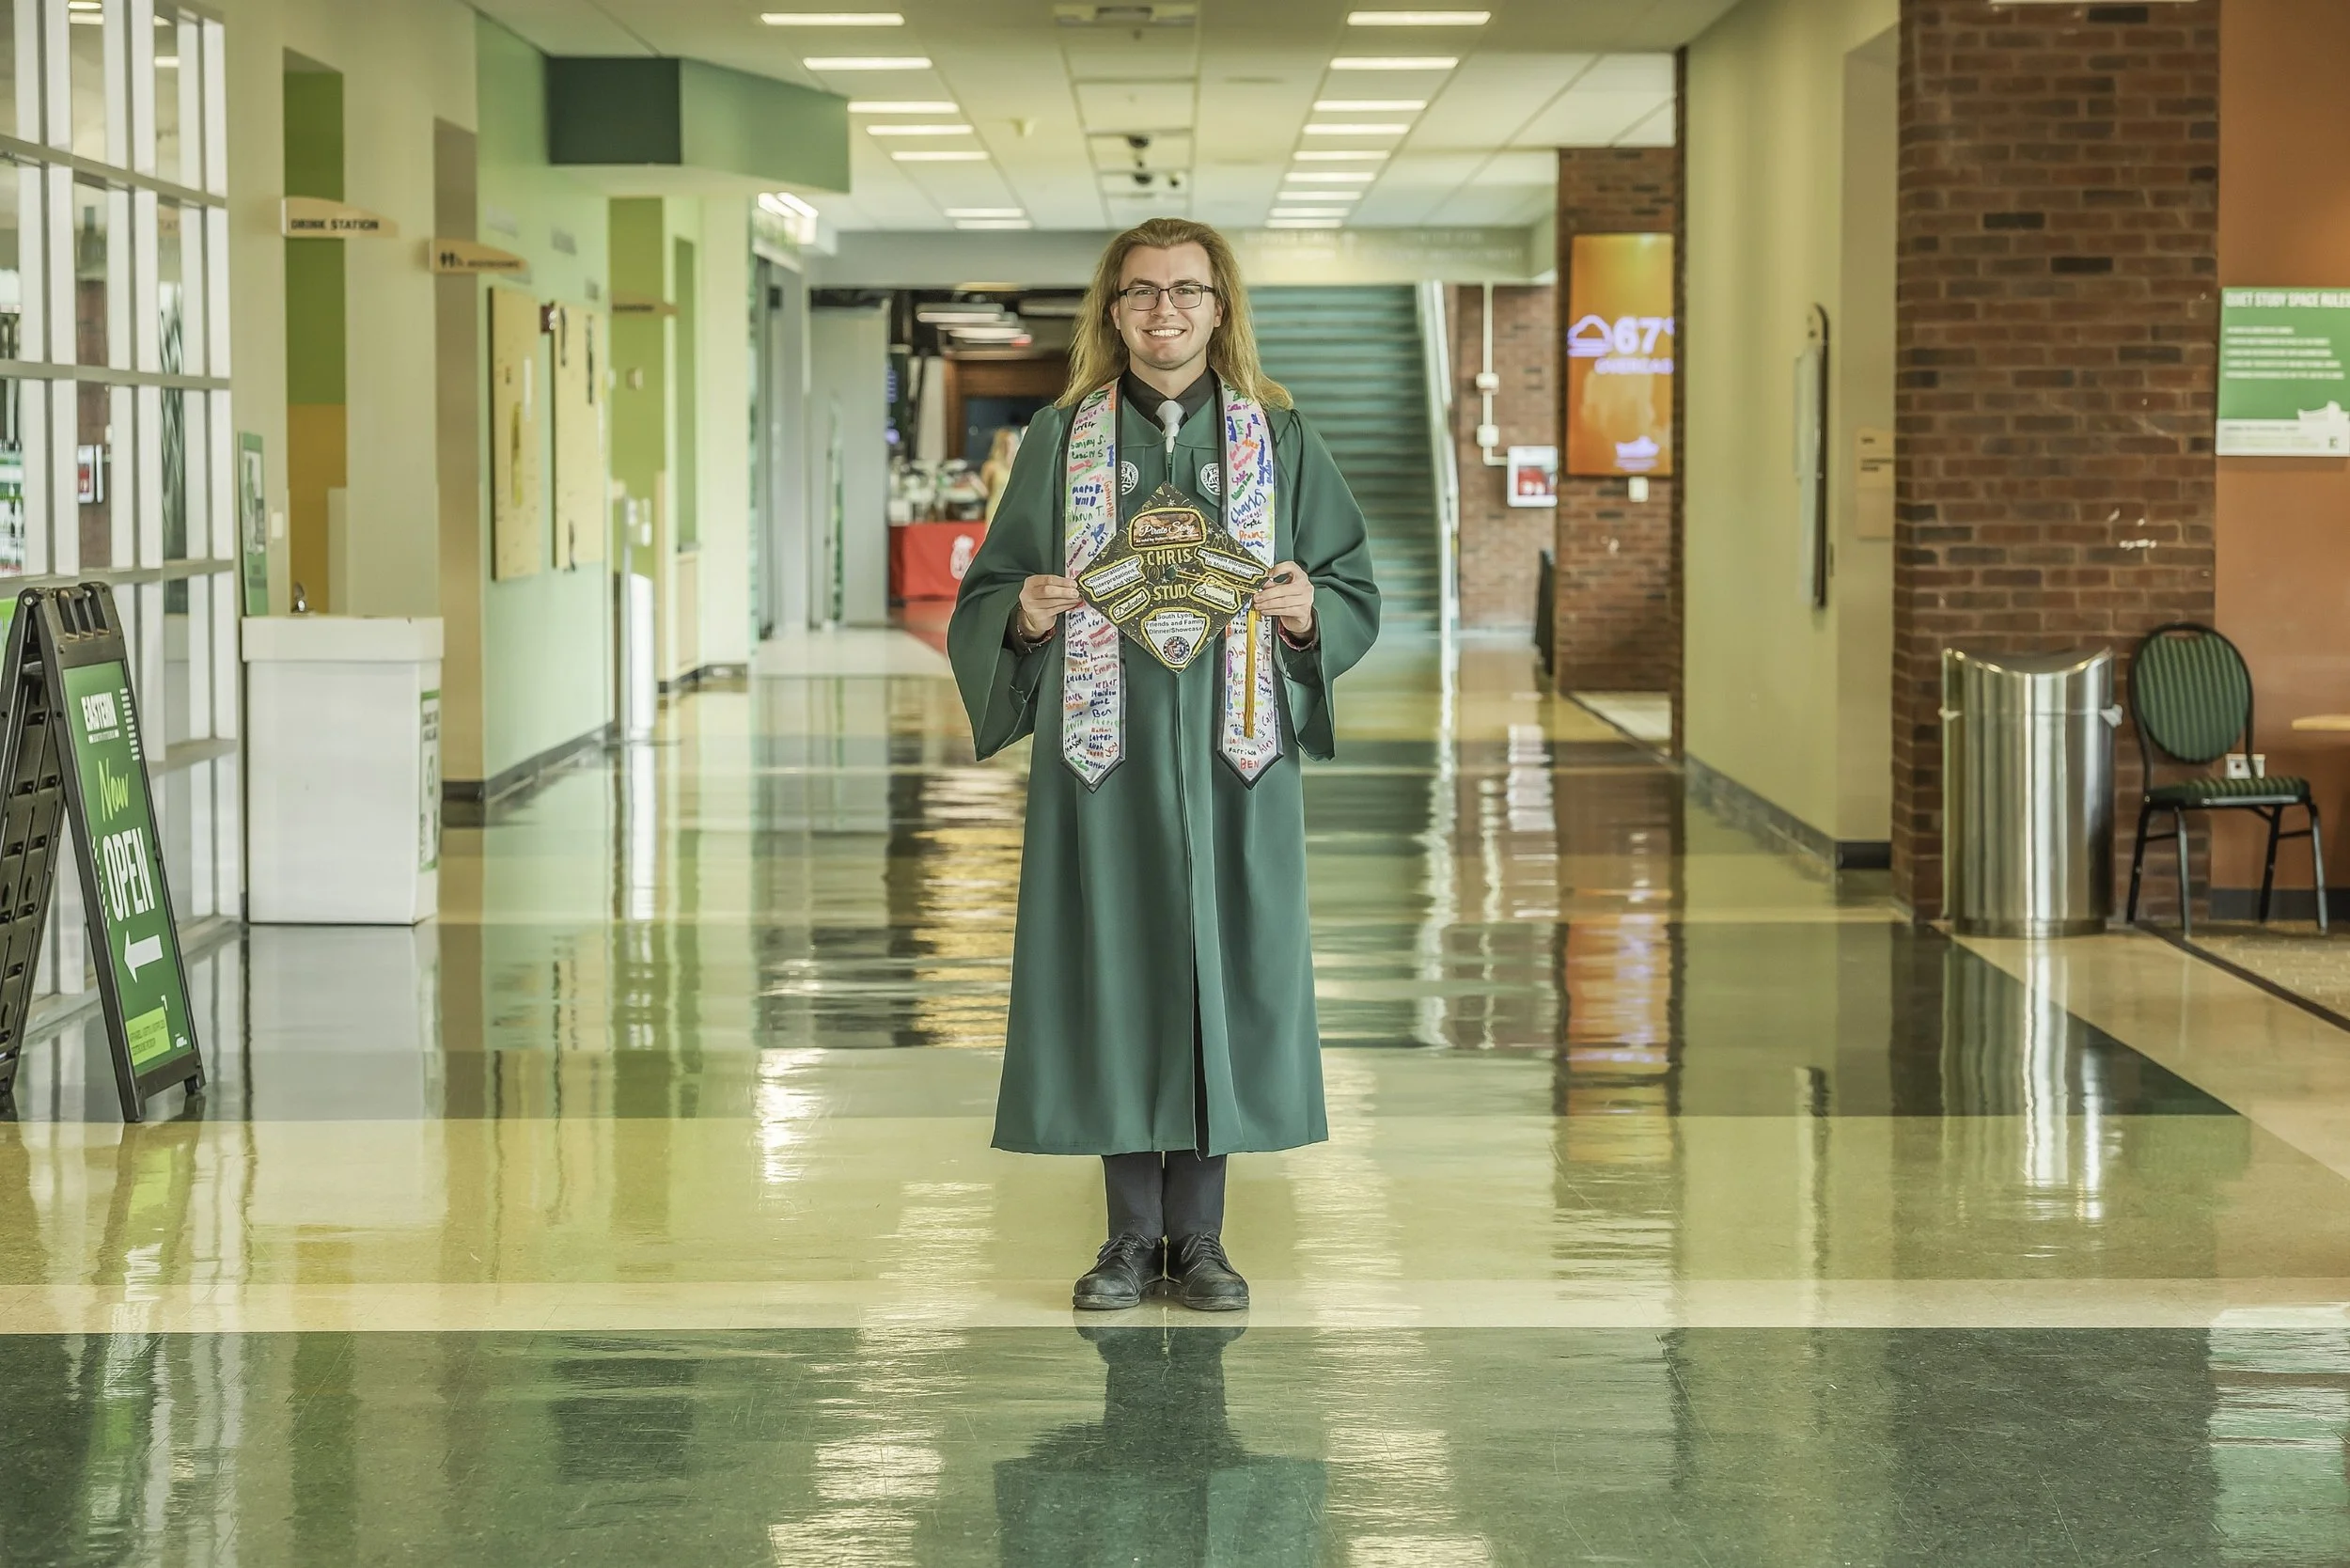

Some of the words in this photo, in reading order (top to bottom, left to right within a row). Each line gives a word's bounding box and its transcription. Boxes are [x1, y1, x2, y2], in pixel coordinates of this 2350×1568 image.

[331, 218, 379, 231] STATION
[1139, 525, 1168, 537] Pirate
[1167, 521, 1195, 534] Story
[1147, 548, 1191, 566] CHRIS
[1198, 551, 1228, 564] Freshman
[1228, 558, 1264, 575] Introduction
[1086, 565, 1127, 585] Collaborations
[1128, 557, 1139, 567] and
[1213, 561, 1230, 572] Music
[1231, 567, 1252, 578] School
[1095, 587, 1112, 596] Black
[1123, 572, 1141, 583] White
[1153, 585, 1187, 601] STUD
[1149, 626, 1203, 635] Dinner/Showcase
[81, 692, 118, 732] EASTERN
[1240, 758, 1260, 770] BEN
[98, 757, 130, 823] Now
[102, 826, 155, 922] OPEN
